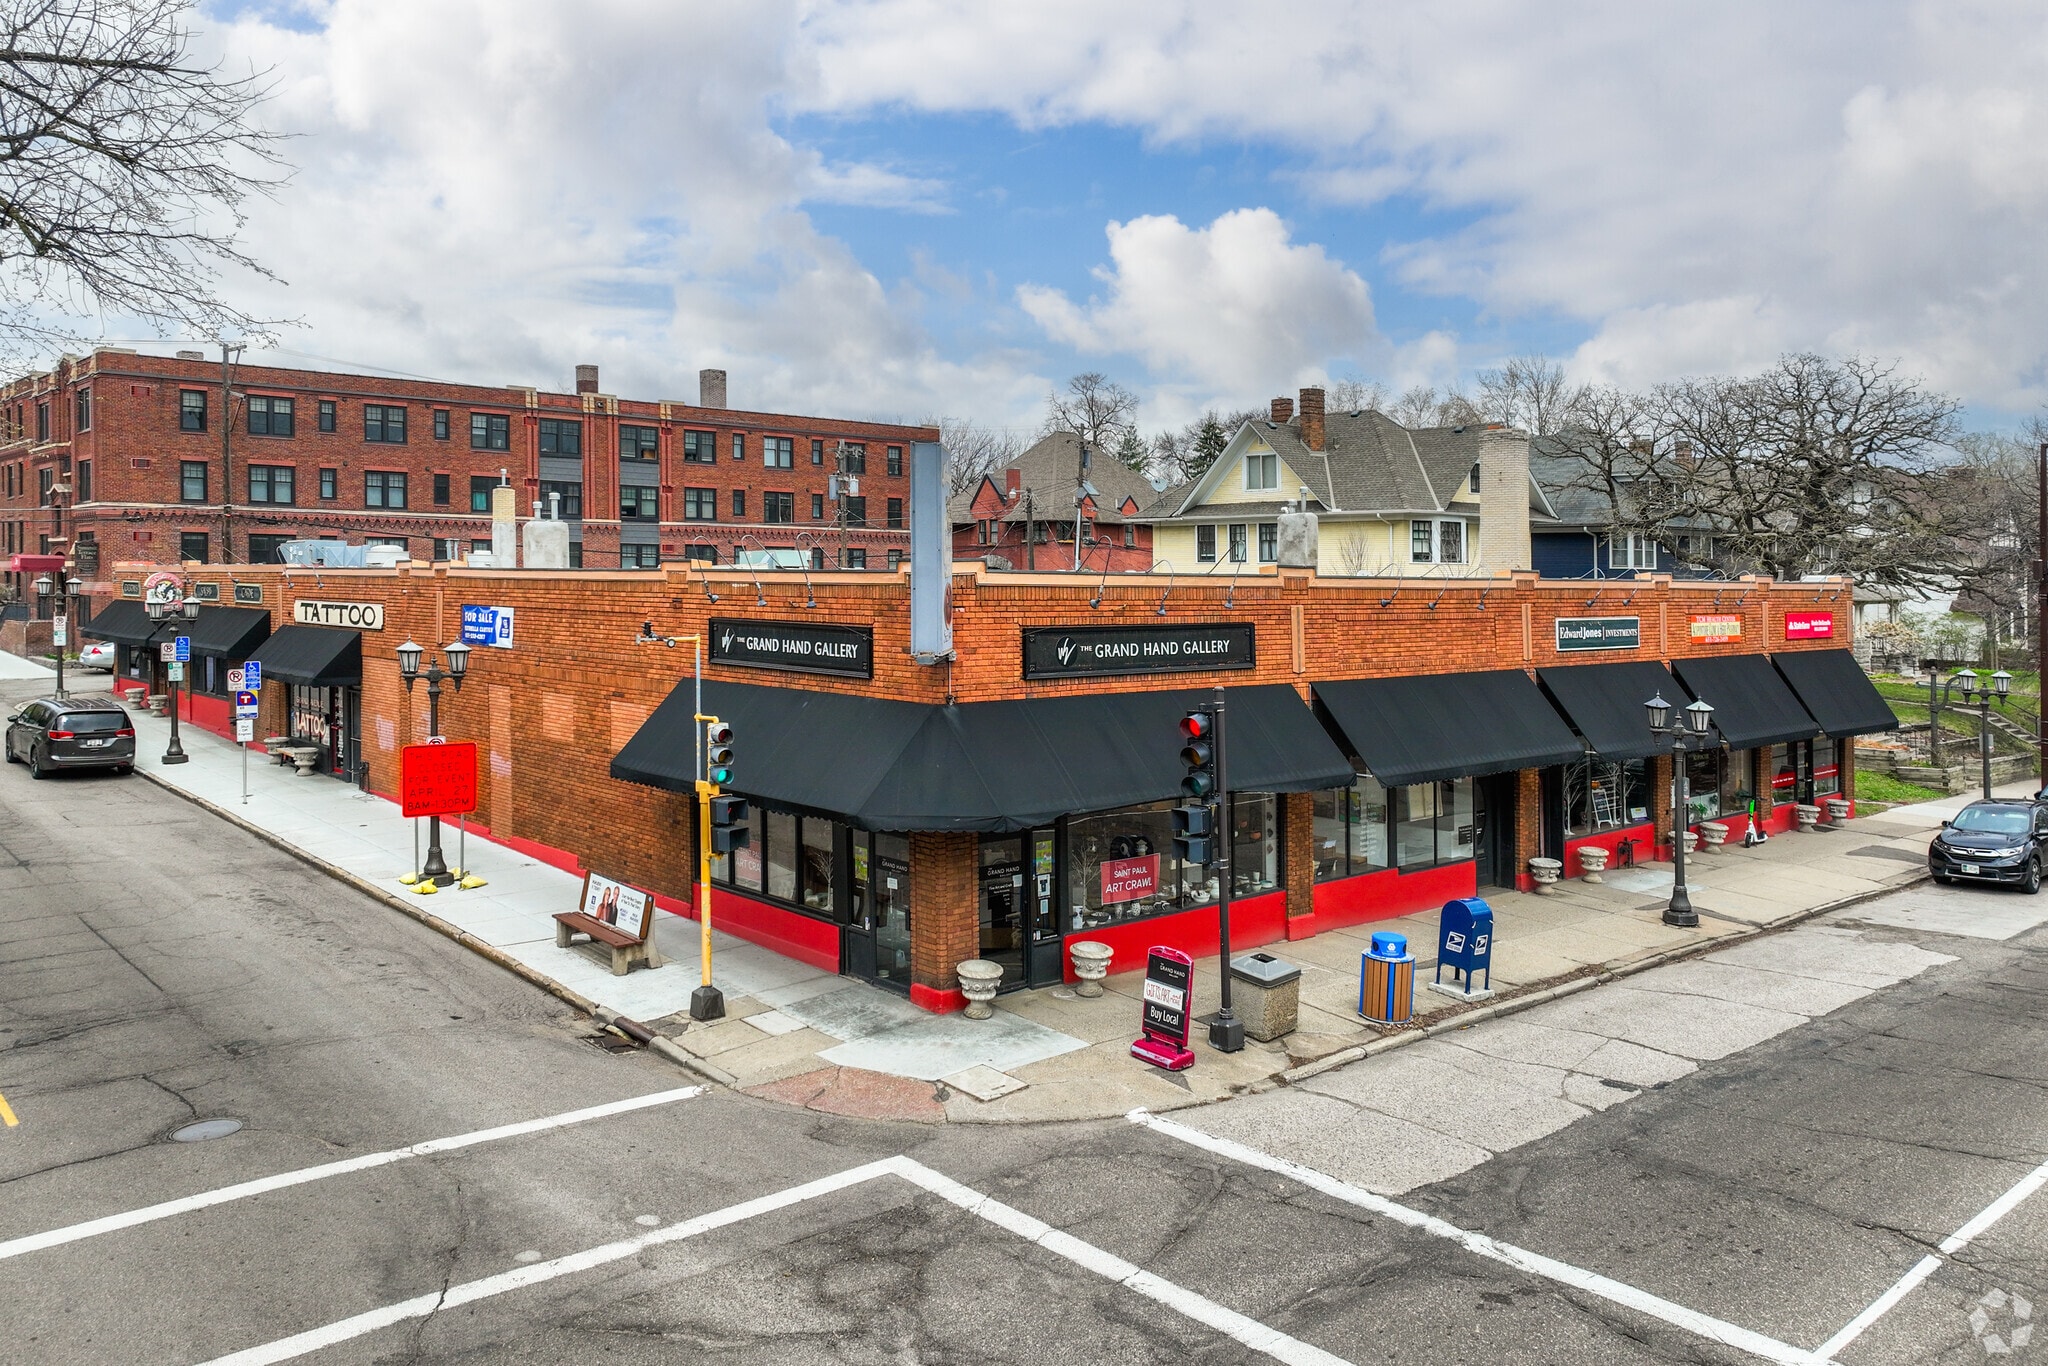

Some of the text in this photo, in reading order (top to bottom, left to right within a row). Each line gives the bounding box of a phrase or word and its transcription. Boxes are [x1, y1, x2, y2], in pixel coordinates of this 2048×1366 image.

[300, 602, 376, 627] TATTOO
[464, 611, 494, 624] FOR SALE
[746, 636, 779, 652] GRAND
[782, 639, 811, 655] HAND
[814, 641, 858, 659] GALLERY
[1095, 642, 1139, 658] GRAND
[1143, 641, 1179, 656] HAND
[1182, 639, 1230, 654] GALLERY
[409, 749, 470, 761] THIS ROAD
[419, 761, 462, 773] CLOSED
[408, 772, 470, 786] FOR EVENT
[409, 784, 469, 798] APRIL 27
[987, 865, 1020, 877] GRAND HAND
[1113, 866, 1148, 879] SAINT PAUL
[1105, 877, 1152, 893] ART CRAWL
[1159, 965, 1186, 978] GRAND HAND
[1150, 1005, 1179, 1026] Buy Local
